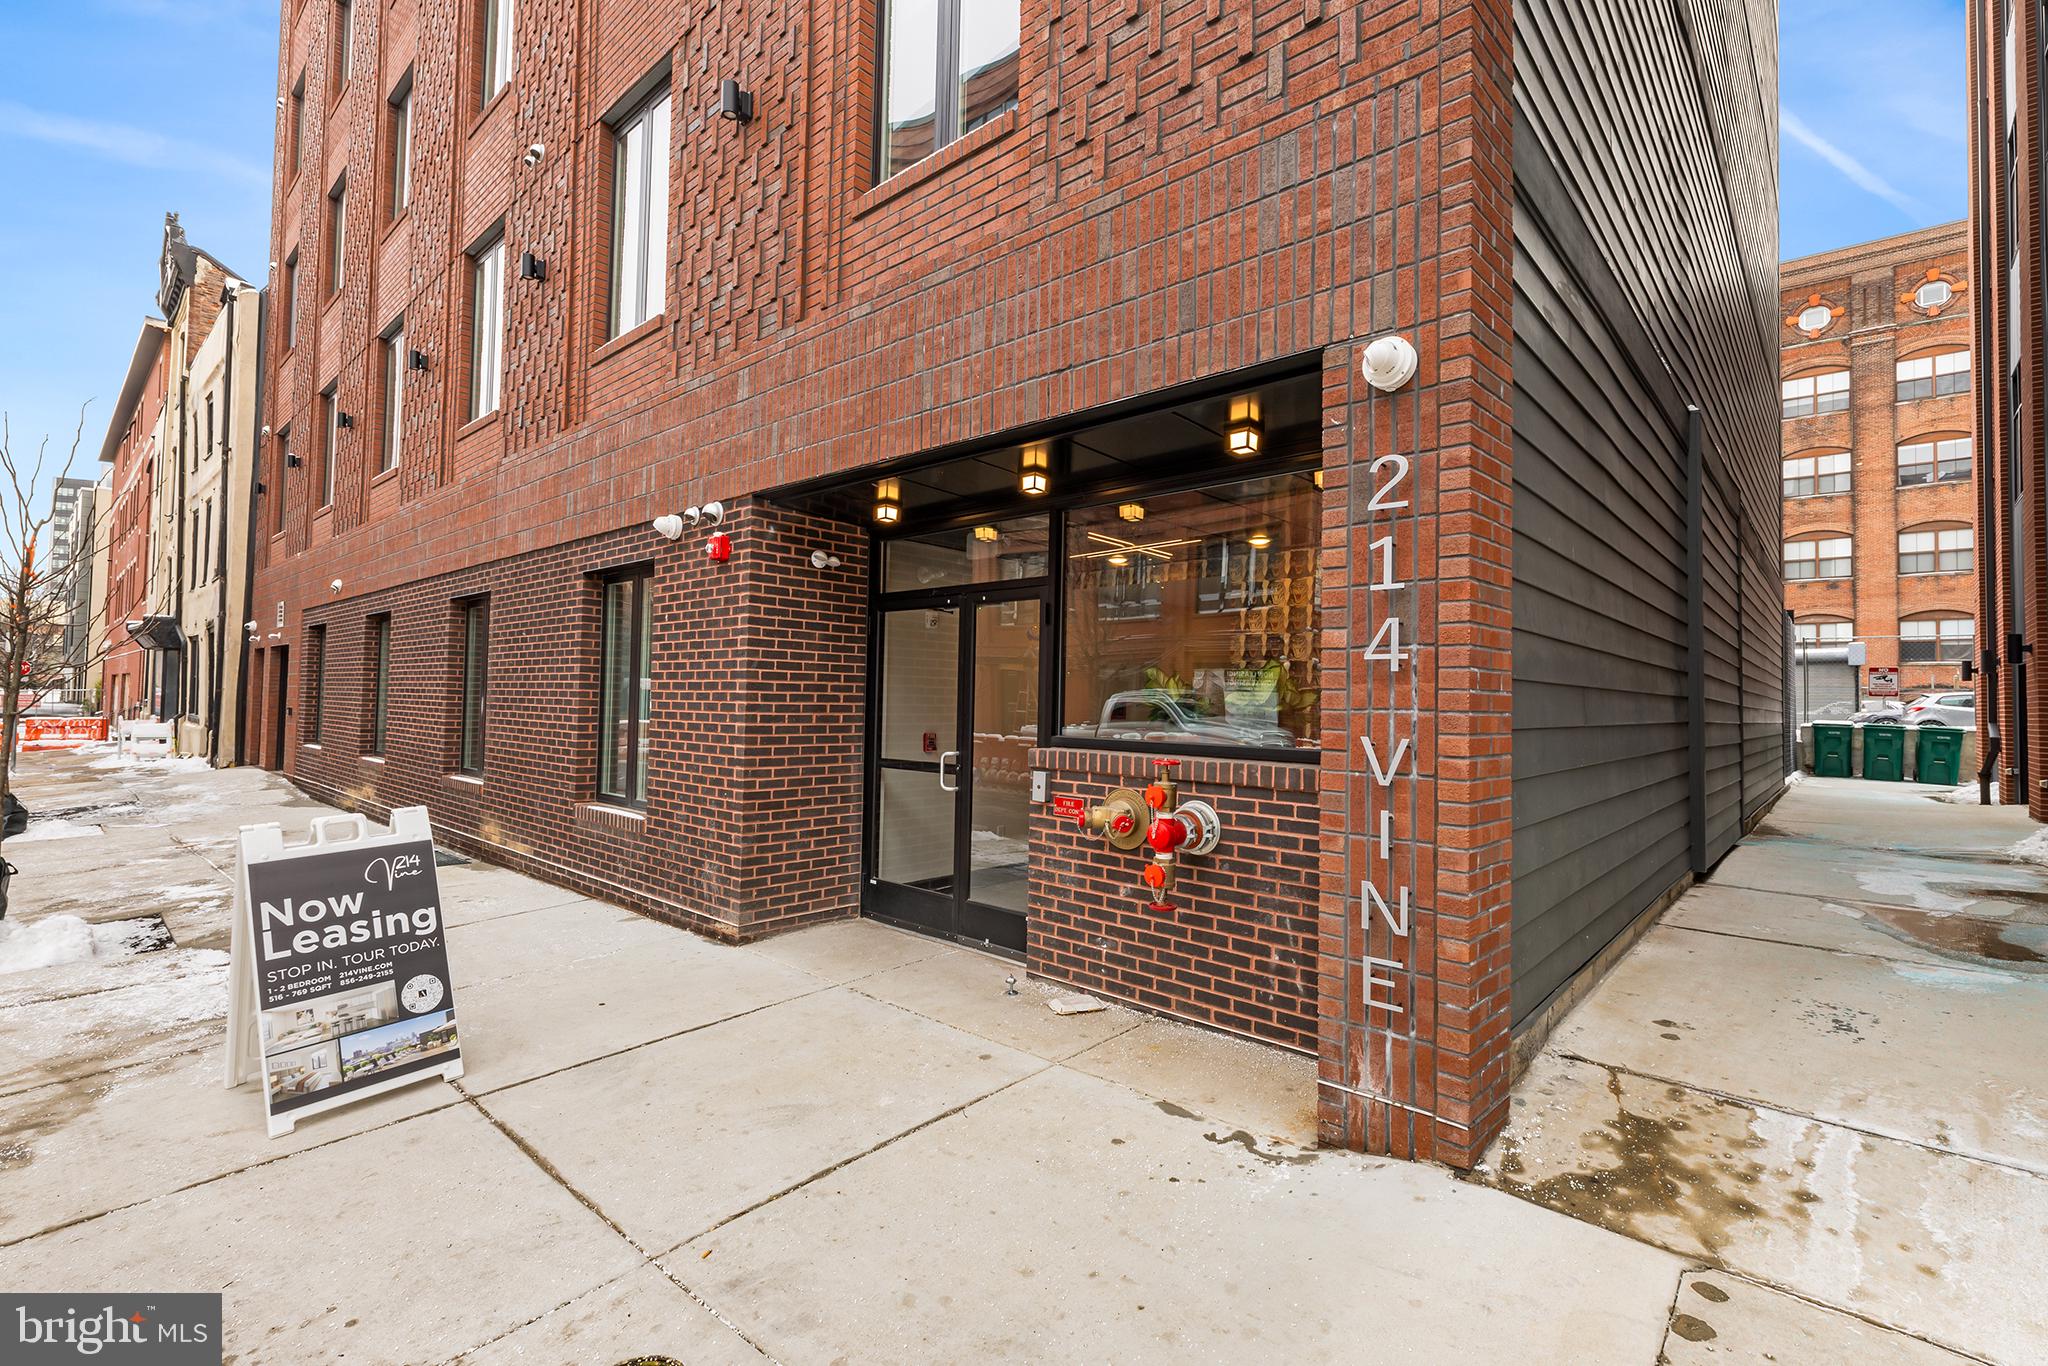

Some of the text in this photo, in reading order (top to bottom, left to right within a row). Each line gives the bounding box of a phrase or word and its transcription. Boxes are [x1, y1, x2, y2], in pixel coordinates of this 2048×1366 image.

[1359, 735, 1411, 1014] VINE
[260, 892, 364, 931] Now
[262, 906, 438, 961] Leasing
[267, 937, 440, 983] STOP IN. TOUR TODAY.
[338, 961, 394, 979] 214VINE.COM
[268, 994, 284, 1003] 516
[291, 988, 308, 998] 769
[309, 982, 333, 994] SQFT
[287, 975, 333, 991] BEDROOM
[339, 968, 395, 987] 856-249-2155
